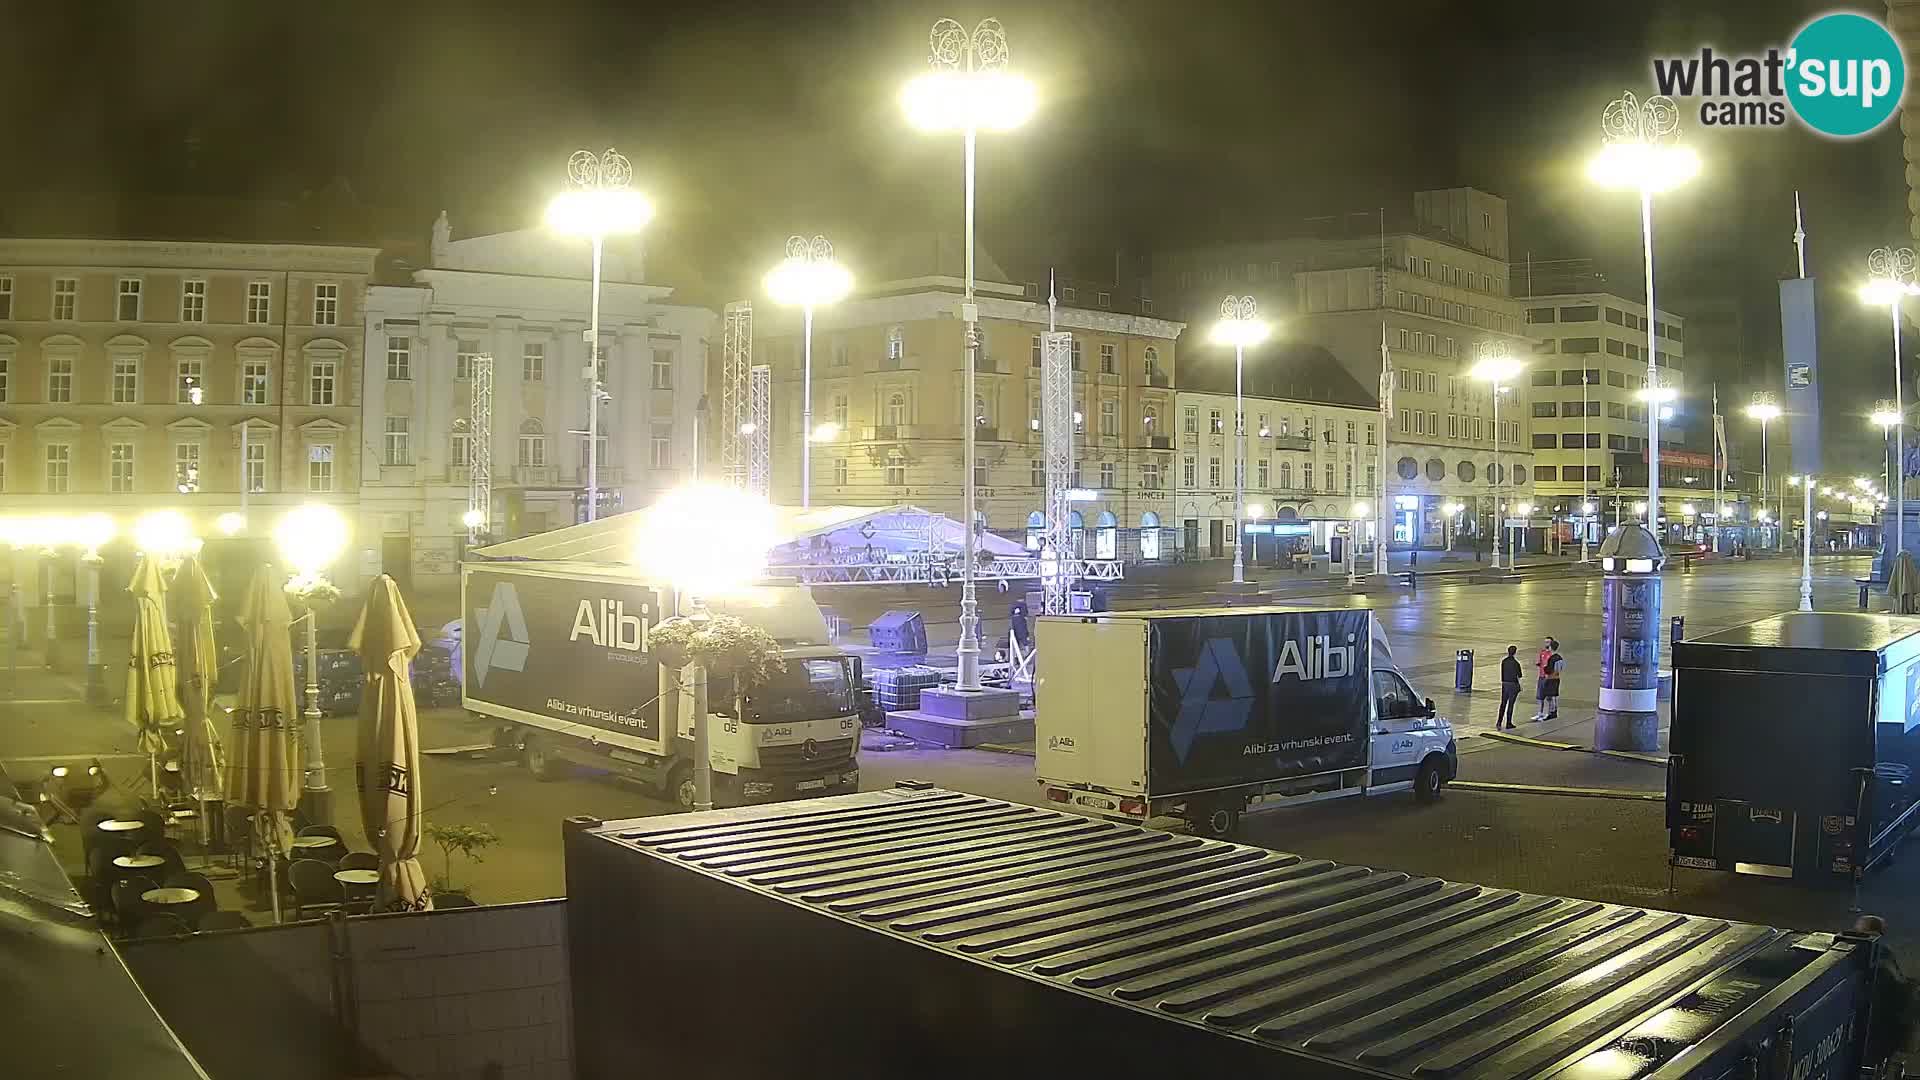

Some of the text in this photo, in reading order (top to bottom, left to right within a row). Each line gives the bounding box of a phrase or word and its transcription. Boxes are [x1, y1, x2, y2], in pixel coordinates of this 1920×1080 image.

[570, 599, 648, 653] Alibi
[1273, 633, 1355, 683] Alibi
[547, 698, 648, 729] Alibi za vrhunski event.
[724, 722, 737, 734] 06
[1243, 743, 1266, 756] Alibi
[1268, 743, 1280, 752] za
[1281, 736, 1323, 751] vrhunski
